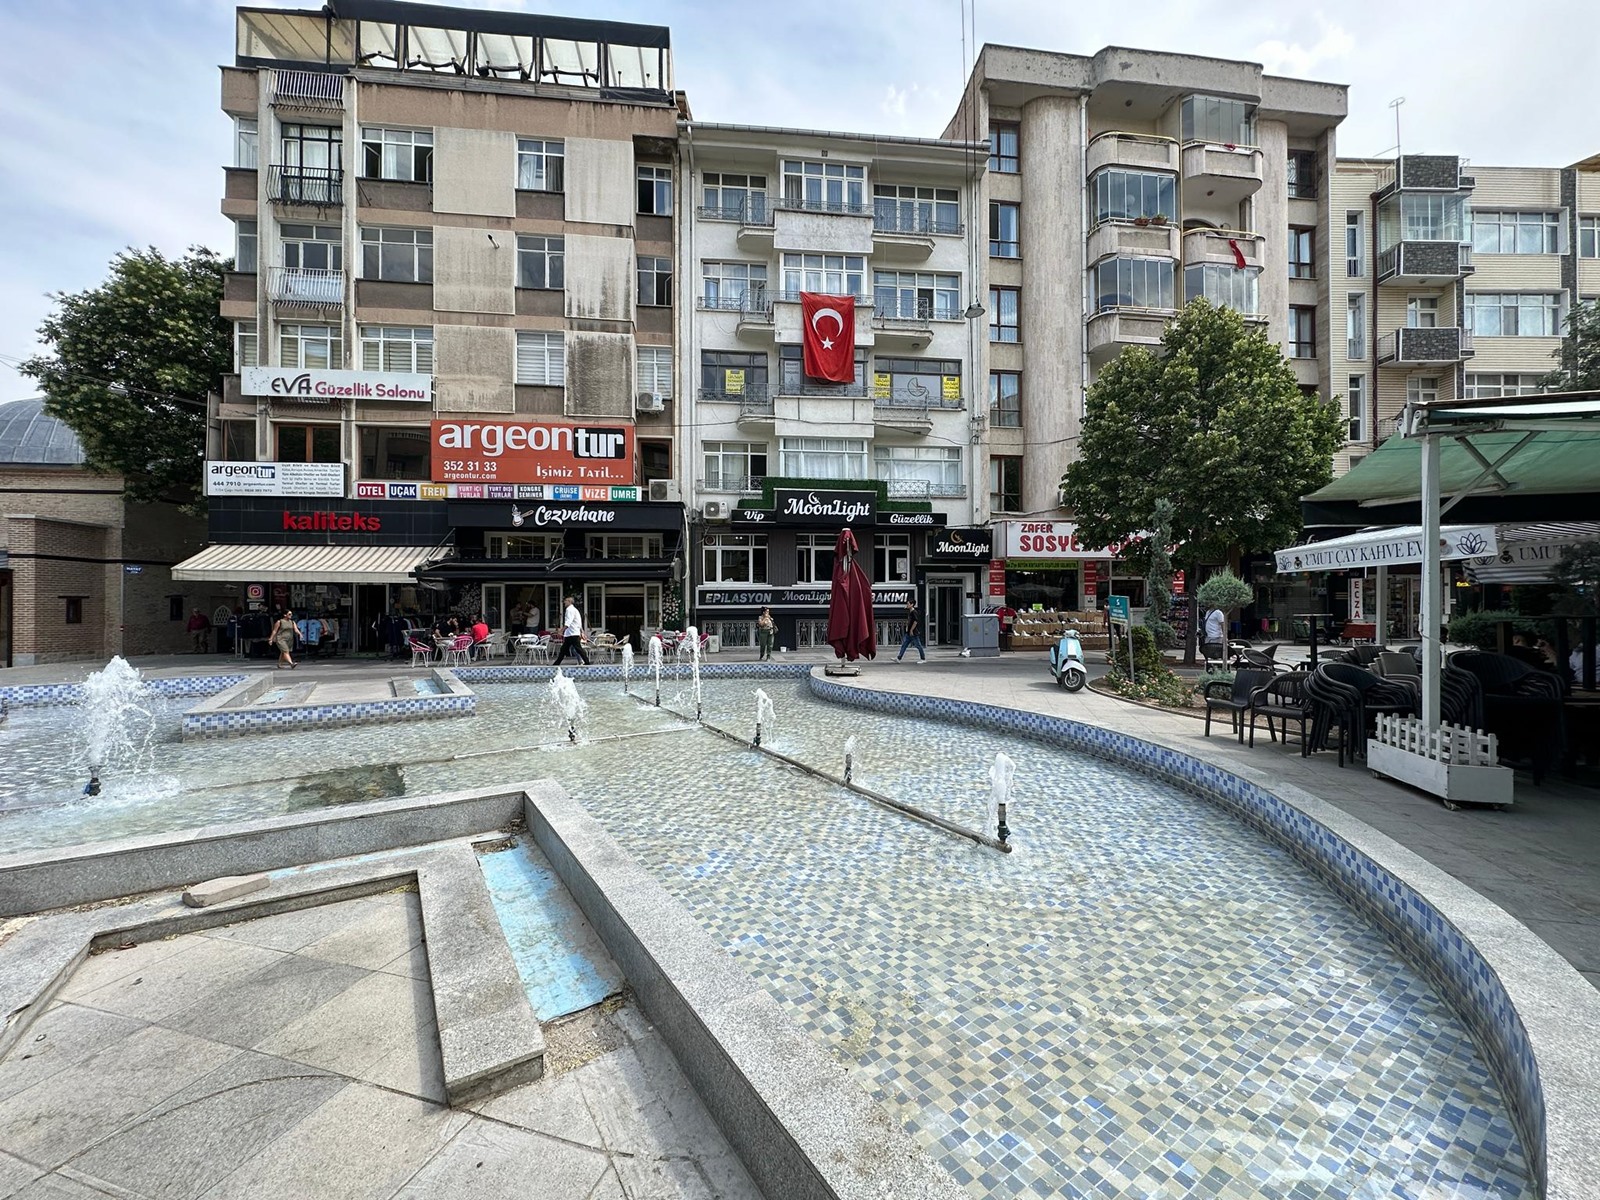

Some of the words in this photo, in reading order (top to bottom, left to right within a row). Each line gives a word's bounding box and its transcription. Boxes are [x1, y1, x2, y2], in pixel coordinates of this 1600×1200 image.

[271, 374, 312, 395] EVA
[315, 382, 372, 397] Güzellik
[375, 384, 425, 399] Salonu
[439, 424, 624, 457] argeontur
[444, 461, 463, 471] 352
[467, 462, 480, 471] 31
[484, 462, 497, 472] 33
[444, 472, 497, 480] argeontur.com
[359, 486, 384, 496] OTEL
[390, 486, 416, 497] UÇAK
[422, 487, 446, 497] TREN
[612, 489, 636, 499] UMRE
[535, 505, 615, 525] Cezvehane
[744, 510, 764, 521] Vip
[784, 497, 870, 521] MoonLight
[283, 511, 381, 531] kaliteks
[890, 513, 934, 525] Güzellik
[1021, 523, 1053, 533] ZAFER
[936, 541, 989, 557] MoonLight
[1019, 534, 1082, 552] SOSYE
[1305, 550, 1334, 566] UMUT
[1335, 547, 1358, 566] ÇAY
[1360, 542, 1404, 561] KAHVE
[1519, 543, 1567, 561] UMUT
[782, 590, 831, 604] MoonLigh
